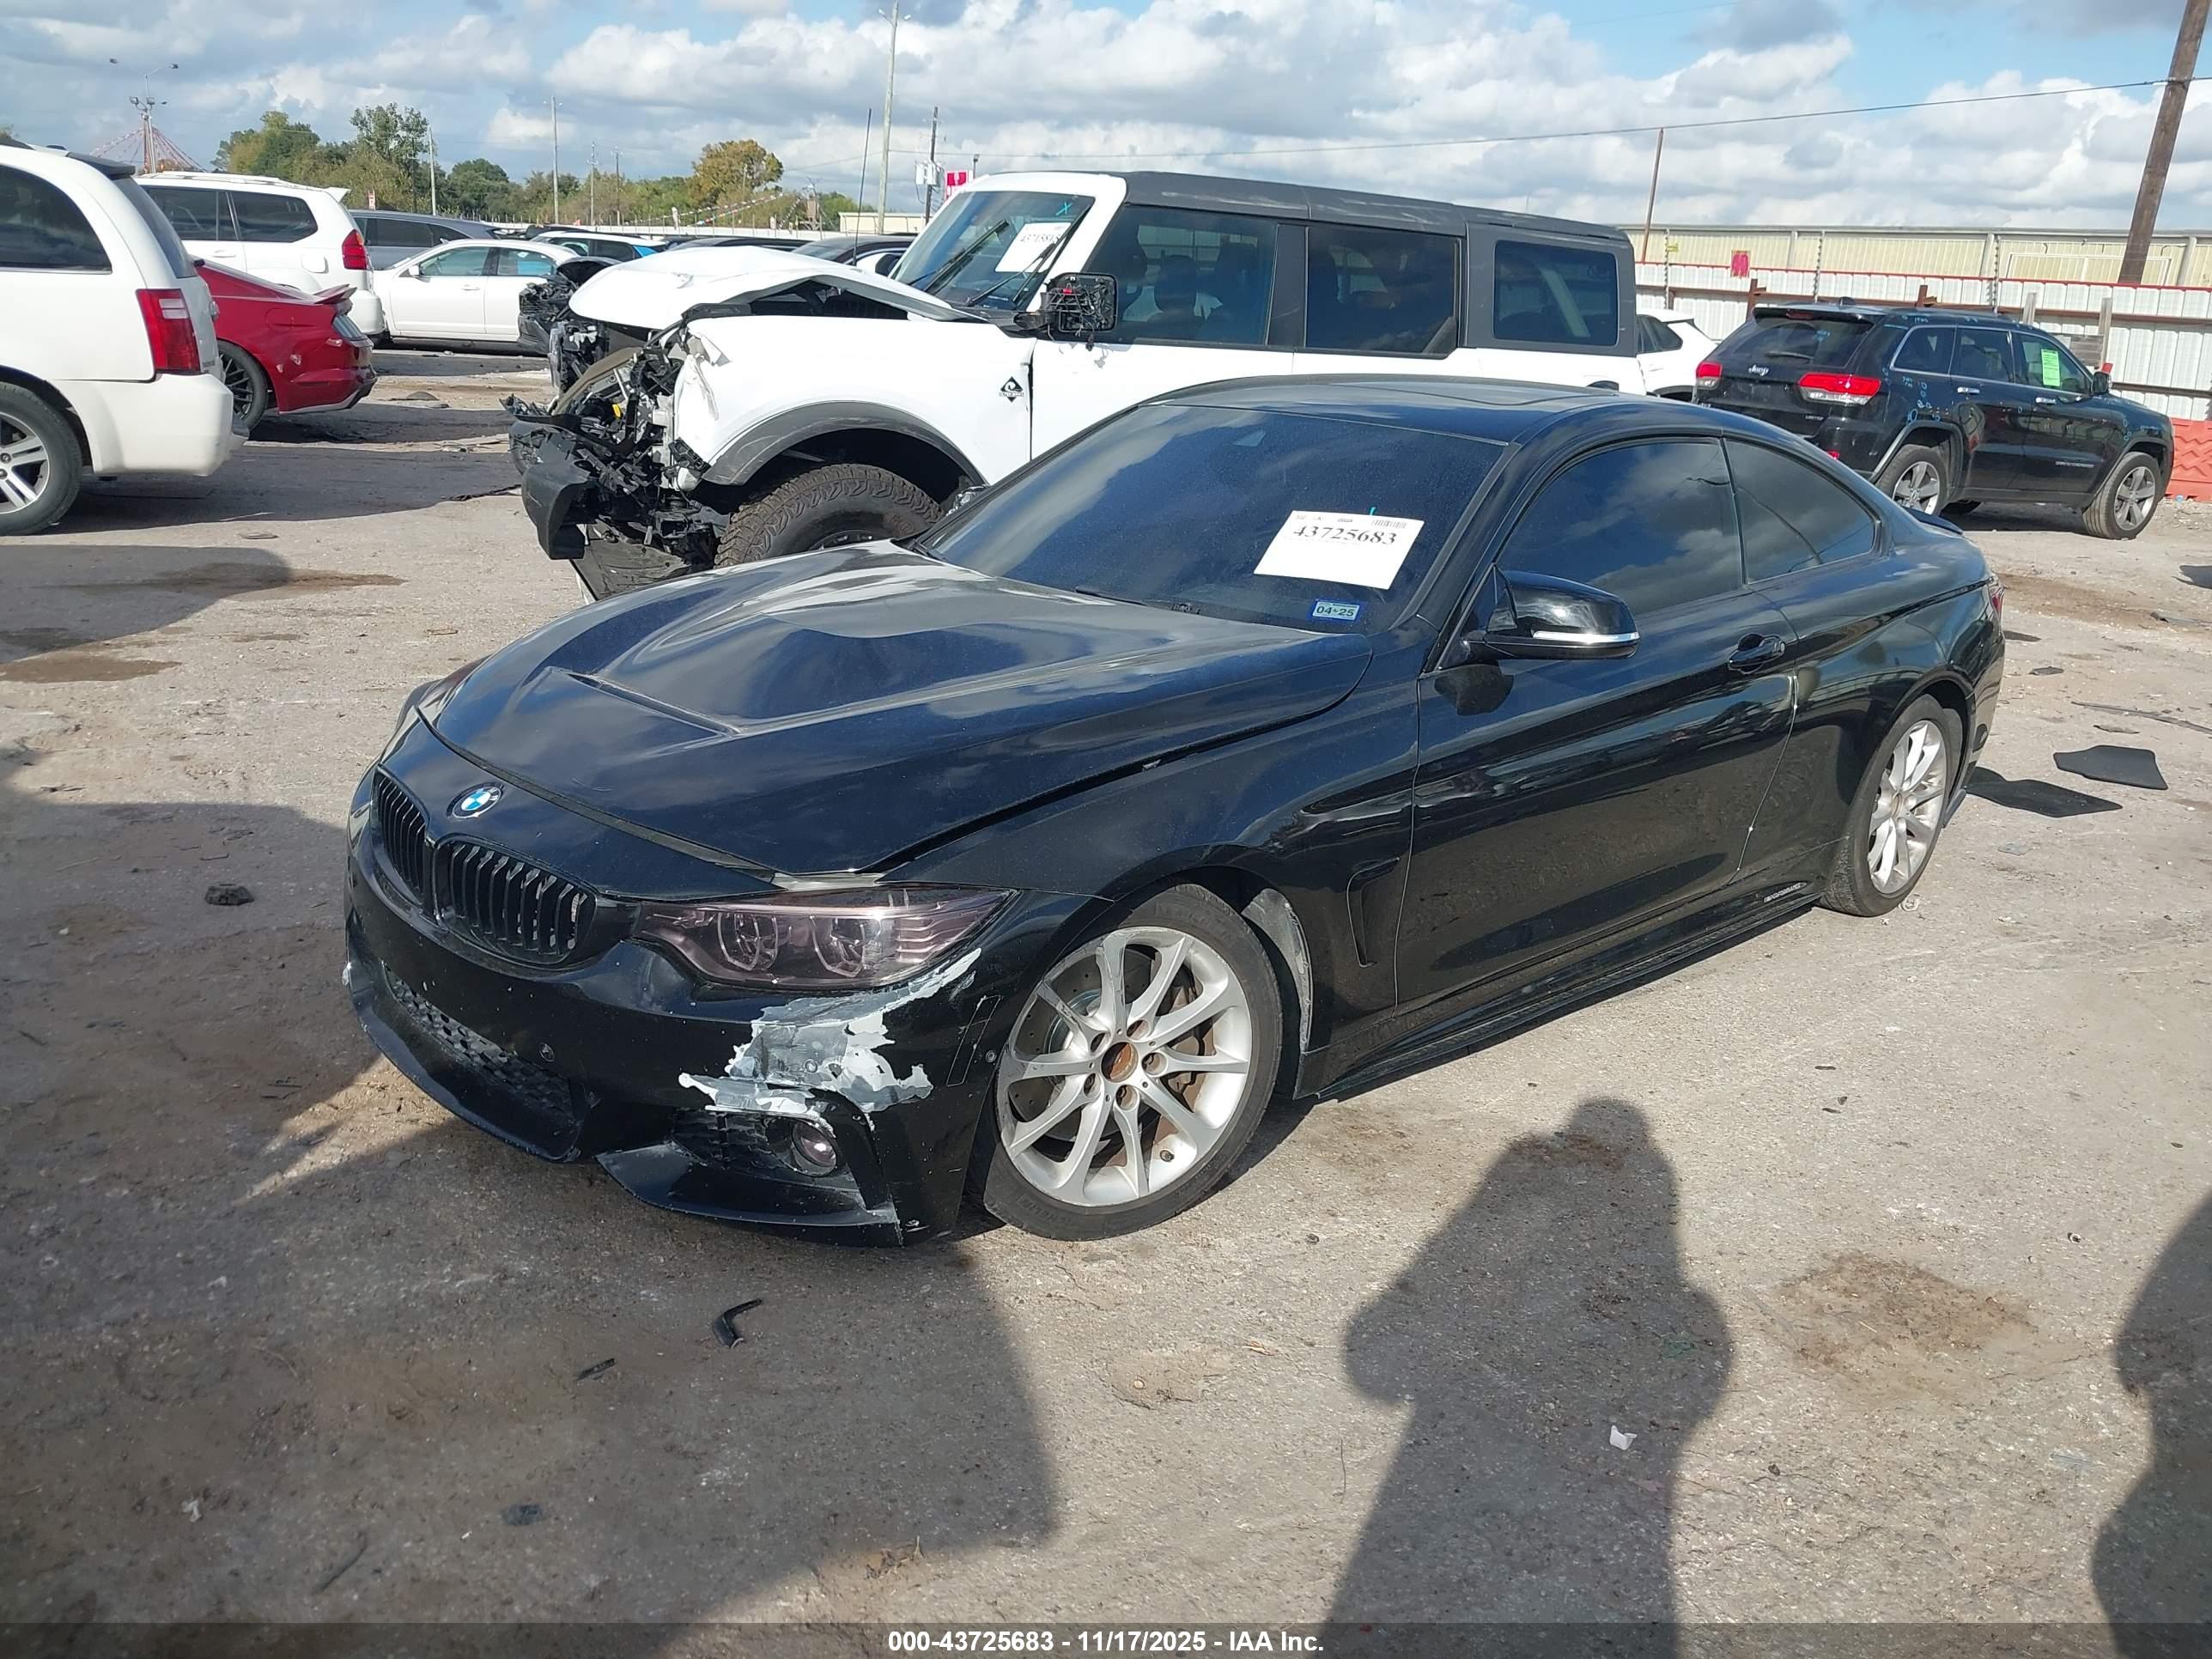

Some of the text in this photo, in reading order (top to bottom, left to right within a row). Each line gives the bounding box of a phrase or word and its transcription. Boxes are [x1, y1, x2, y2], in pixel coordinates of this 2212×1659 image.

[1293, 525, 1397, 545] 43725683
[1316, 605, 1333, 615] 04
[1338, 608, 1354, 617] 25
